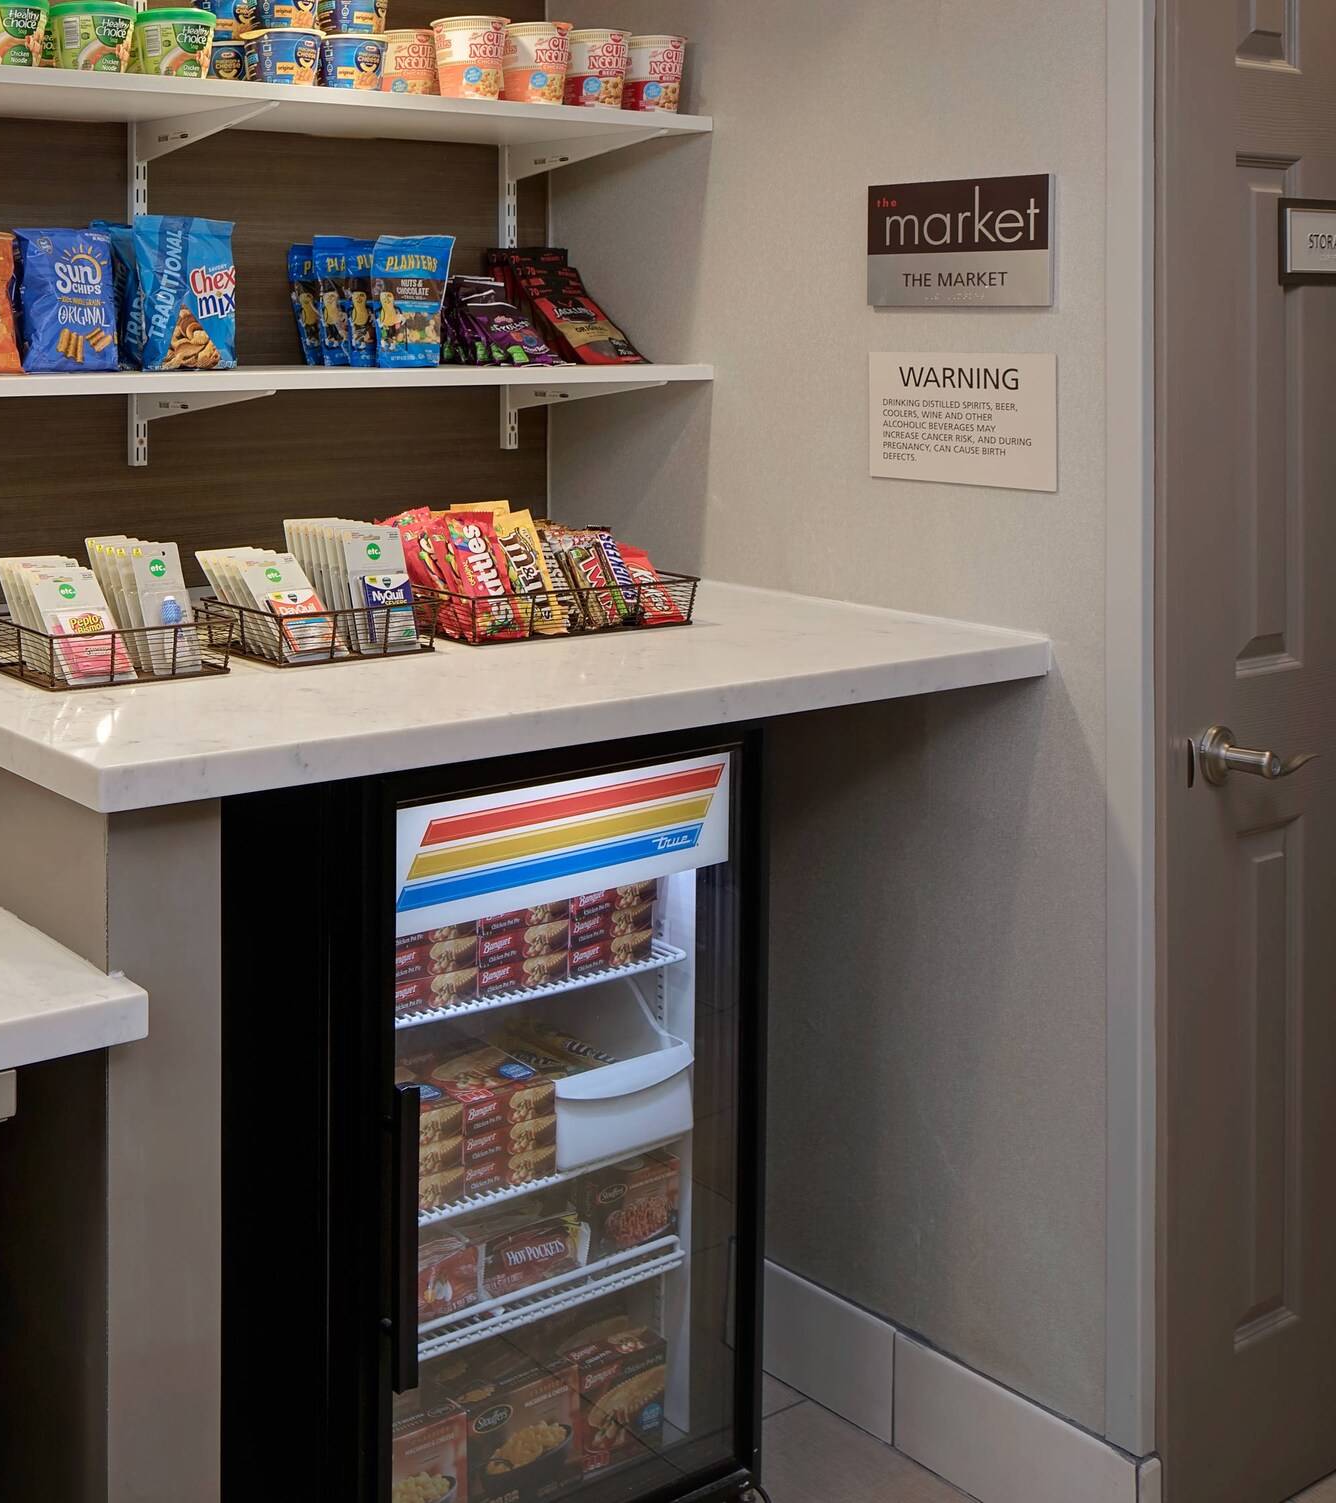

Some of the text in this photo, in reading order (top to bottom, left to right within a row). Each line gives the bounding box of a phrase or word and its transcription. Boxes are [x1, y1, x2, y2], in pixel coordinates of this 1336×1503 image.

[9, 9, 39, 20] Healthy
[3, 17, 36, 29] Choice
[102, 18, 130, 30] Healthy
[96, 26, 126, 38] Choice
[183, 25, 209, 36] Healthy
[176, 32, 206, 44] Choice
[876, 197, 897, 208] the
[885, 186, 1040, 246] market
[386, 254, 438, 272] PLANTERS
[54, 262, 102, 294] Sun
[148, 230, 183, 337] TRADITIONAL
[190, 265, 236, 294] Chex
[400, 279, 417, 287] NUTS
[902, 272, 1008, 287] THE MARKET
[71, 283, 102, 294] CHIPS
[396, 287, 430, 296] CHOCOLATE
[530, 288, 540, 296] 70
[198, 292, 236, 318] mix
[58, 305, 110, 327] ORIGINAL
[898, 366, 1020, 390] WARNING
[882, 398, 1018, 412] DRINKING DISTILLED SPIRITS, BEER,
[882, 409, 992, 422] COOLERS, WINE AND OTHER
[882, 420, 996, 433] ALCOHOLIC BEVERAGES MAY
[882, 430, 1032, 446] INCREASE CANCER RISK, AND DURING
[882, 452, 918, 462] DEFECTS.
[933, 444, 952, 453] CAN
[954, 445, 980, 455] CAUSE
[982, 447, 1006, 456] BIRTH
[367, 548, 381, 556] etc.
[150, 564, 166, 572] etc.
[60, 588, 76, 596] etc.
[372, 589, 404, 604] NyQuil
[579, 890, 604, 907] Banquet
[573, 916, 600, 934] Banquet
[484, 936, 512, 954] Banquet
[396, 952, 416, 966] nquet
[573, 947, 600, 963] Banquet
[483, 967, 511, 984] Banquet
[468, 1102, 497, 1121] Banquet
[467, 1133, 497, 1151] Banquet
[506, 1240, 565, 1266] HOT POCKETS
